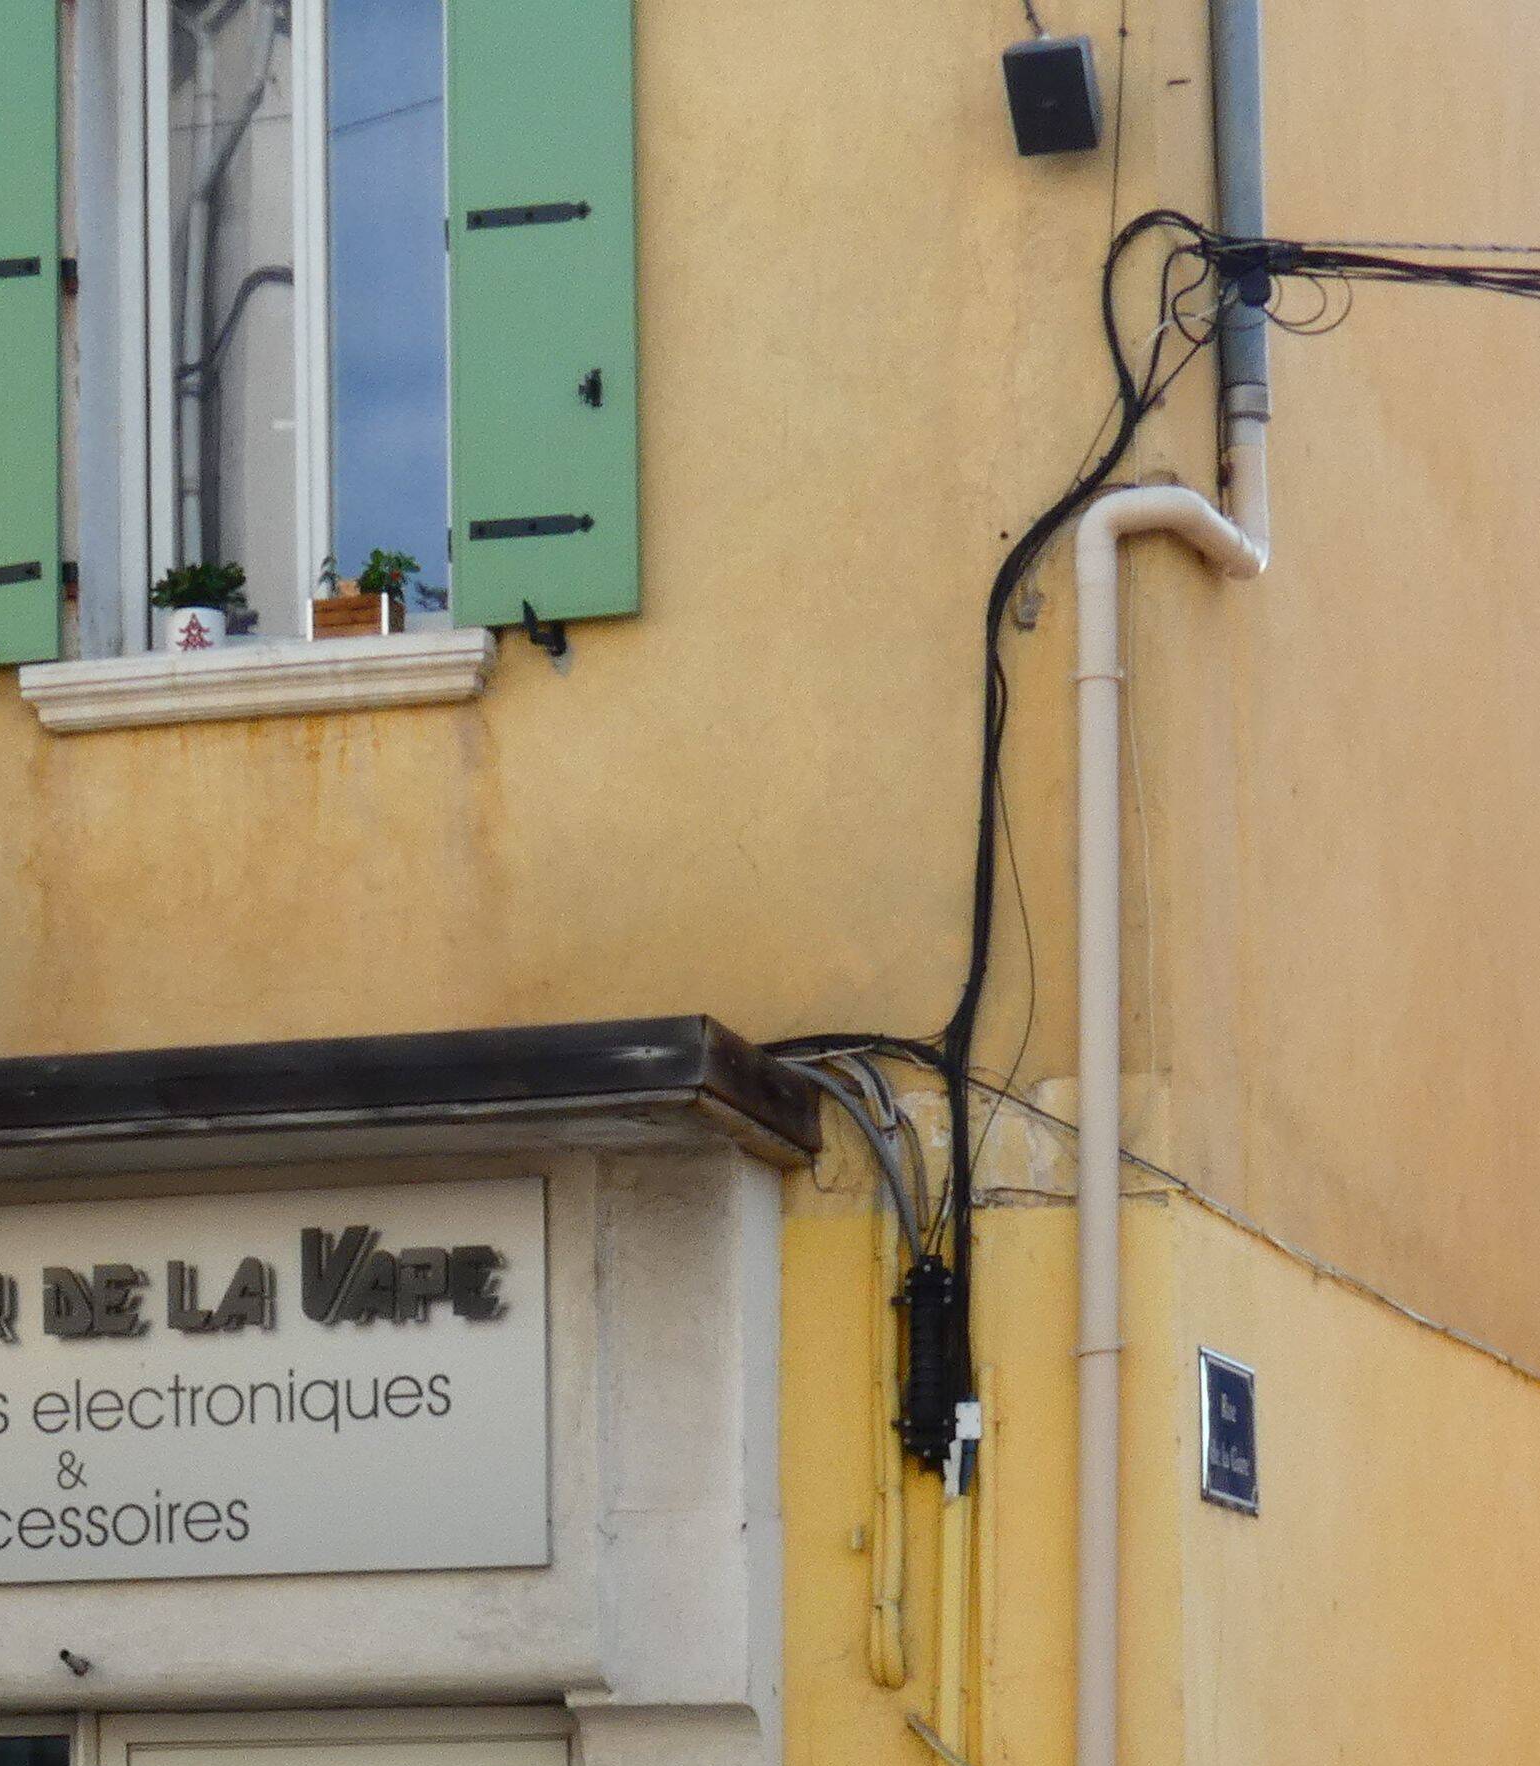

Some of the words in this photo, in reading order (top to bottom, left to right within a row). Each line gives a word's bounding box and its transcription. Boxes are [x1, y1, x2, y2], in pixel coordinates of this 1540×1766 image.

[42, 1264, 151, 1338] DE
[166, 1257, 276, 1334] LA
[301, 1225, 510, 1325] VAPE
[32, 1367, 453, 1434] electroniques
[57, 1449, 88, 1490] &
